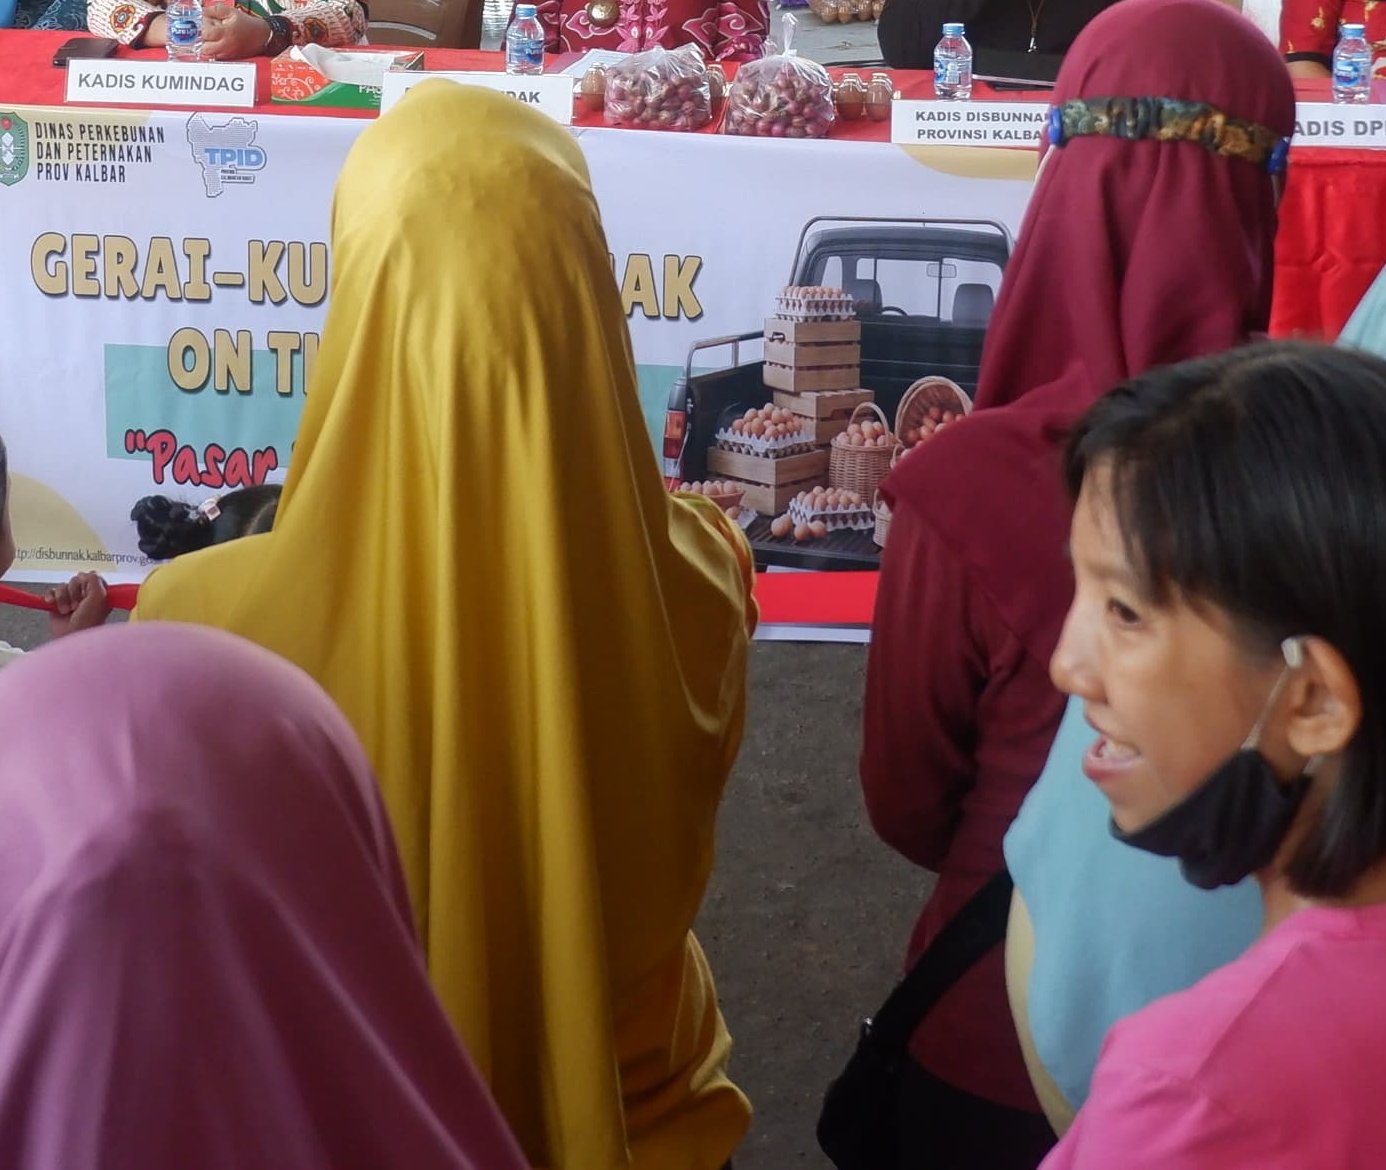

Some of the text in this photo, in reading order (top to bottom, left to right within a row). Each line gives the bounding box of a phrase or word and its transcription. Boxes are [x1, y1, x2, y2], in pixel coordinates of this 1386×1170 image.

[78, 73, 245, 92] KADIS KUMINDAG
[501, 90, 541, 103] DAK
[915, 111, 1049, 123] KADIS DISBUNNA
[35, 122, 165, 144] DINAS PERKEBUNAN
[917, 129, 1042, 141] PROVINSI KALBA
[1294, 120, 1345, 136] ADIS
[36, 143, 152, 163] DAN PETERNAKAN
[204, 147, 264, 167] TPID
[37, 163, 126, 183] PROV KALBAR
[30, 231, 704, 320] GERAI-KU AK
[167, 327, 253, 392] ON
